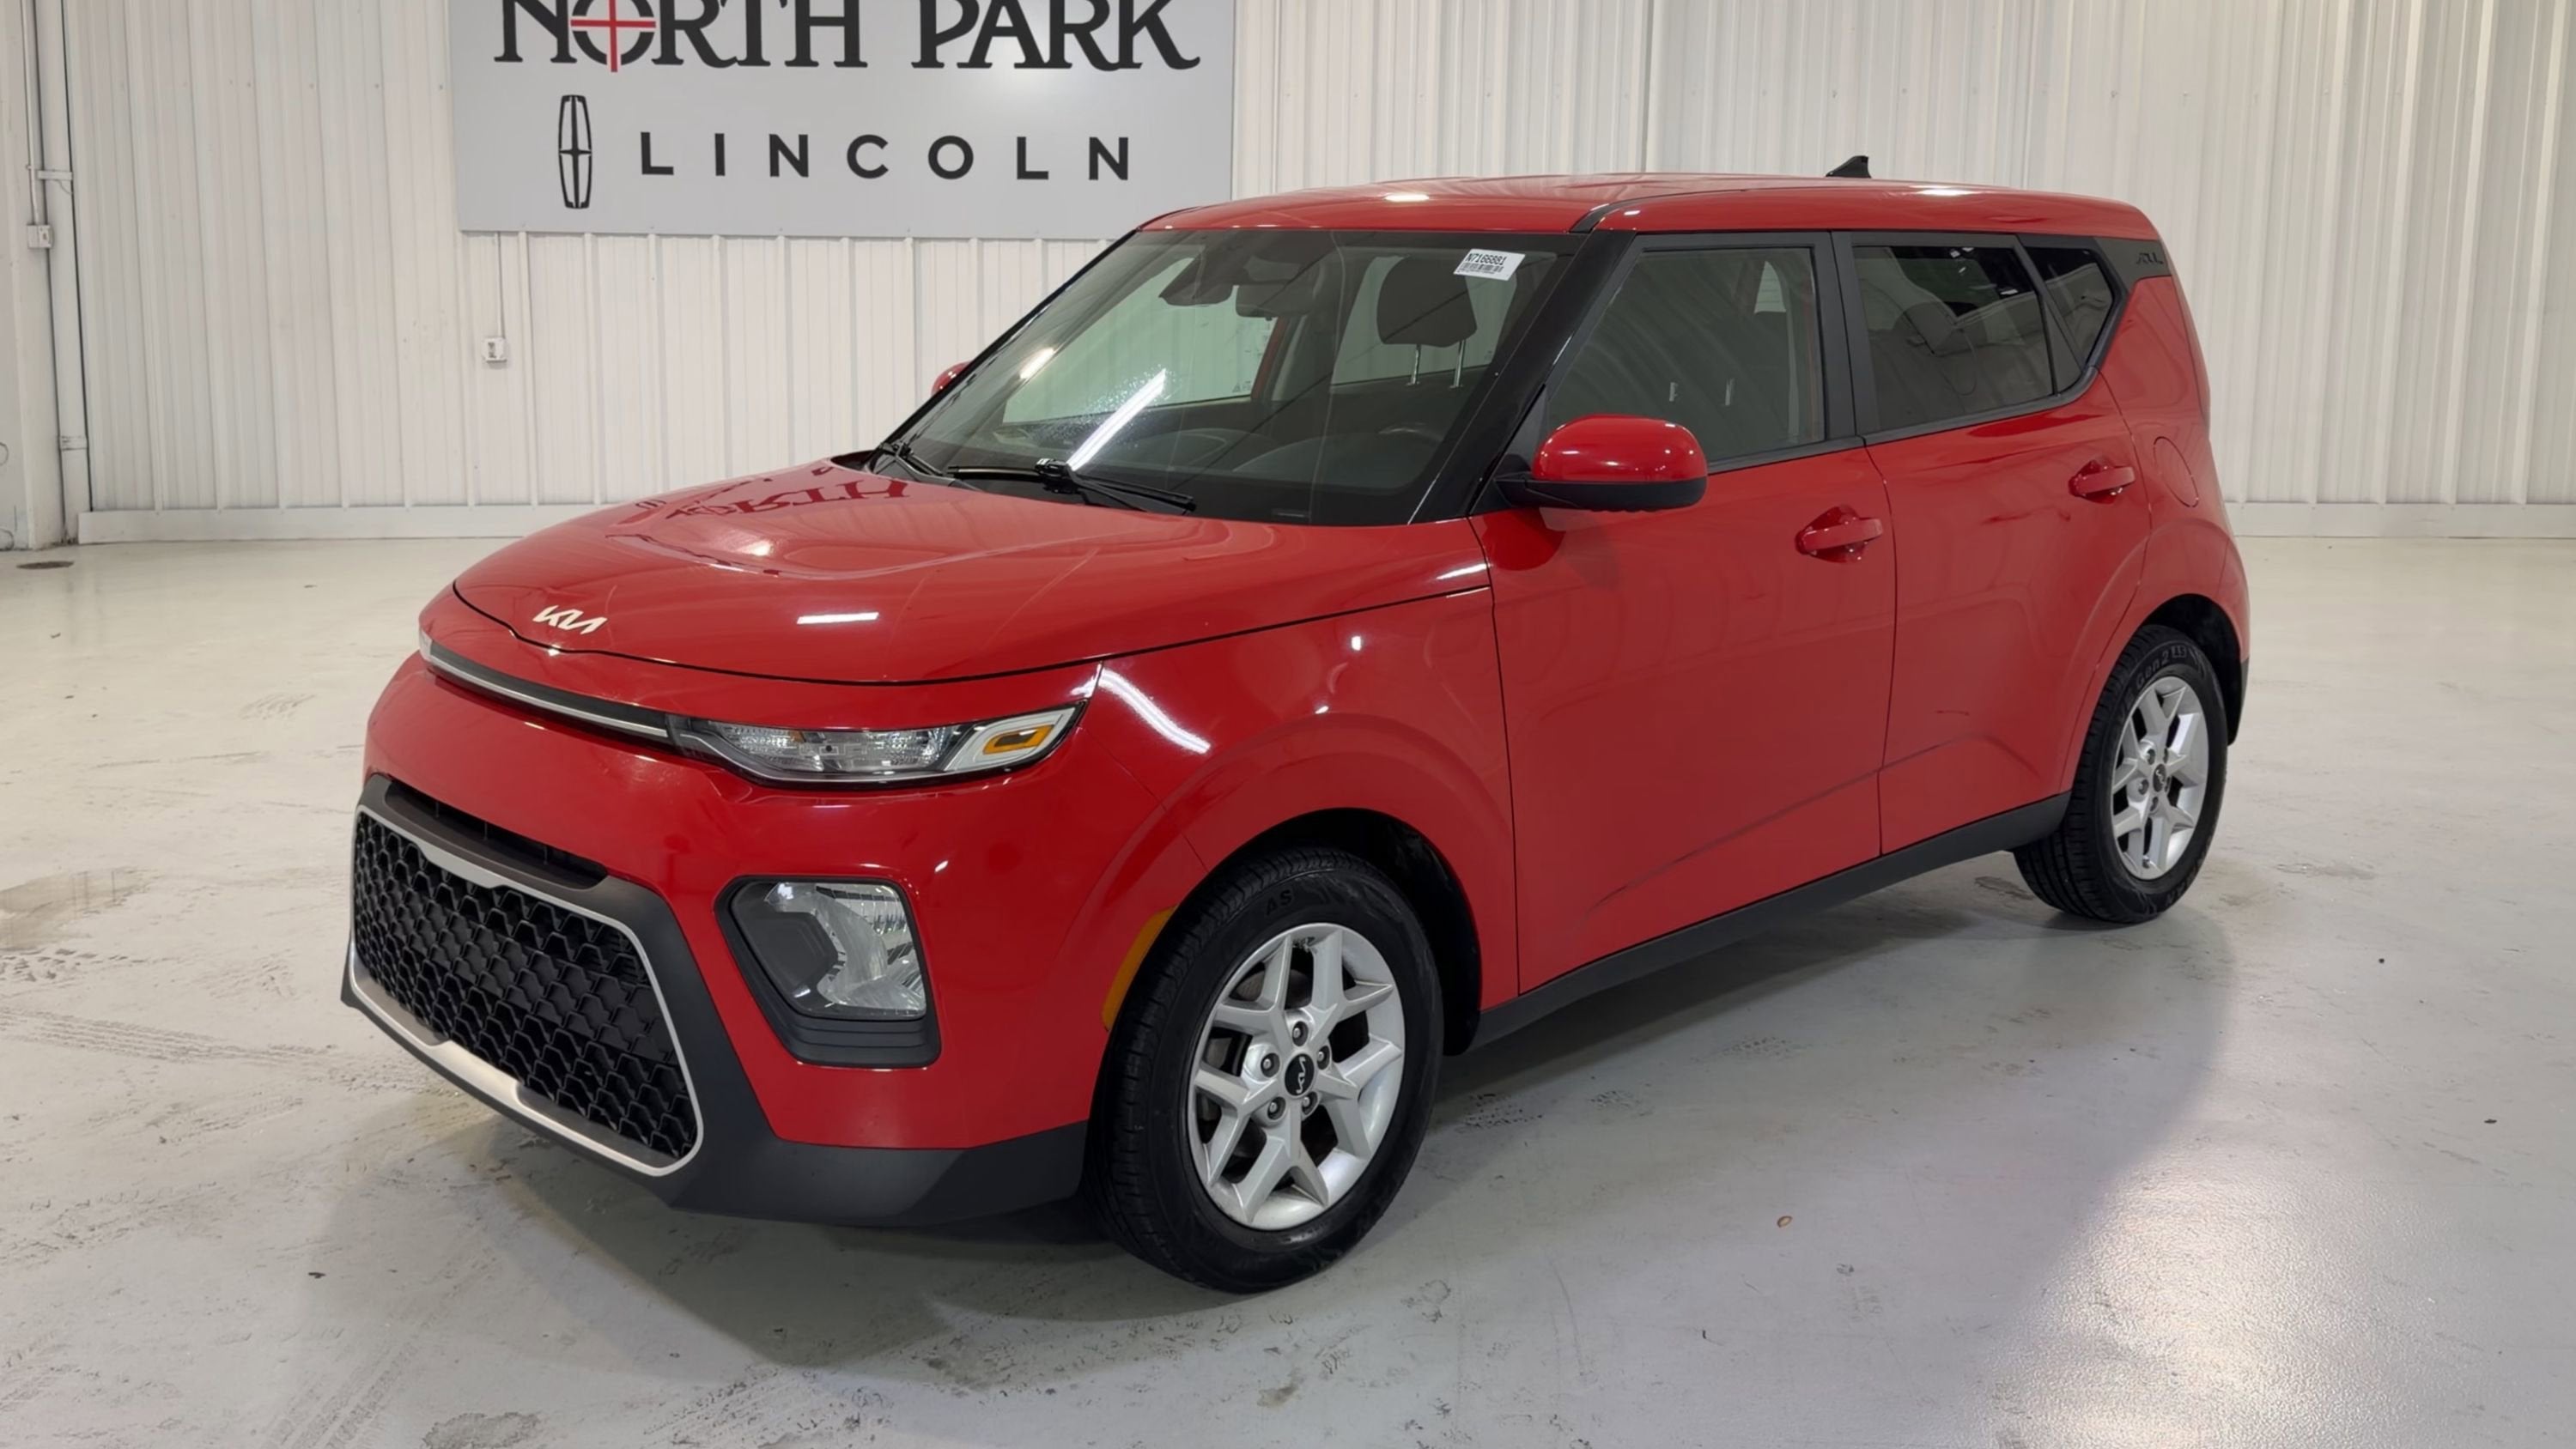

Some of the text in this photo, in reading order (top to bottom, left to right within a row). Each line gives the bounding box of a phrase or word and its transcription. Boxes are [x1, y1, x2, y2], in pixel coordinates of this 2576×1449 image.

[494, 0, 1200, 72] NORTH PARK
[641, 131, 1129, 181] LINCOLN
